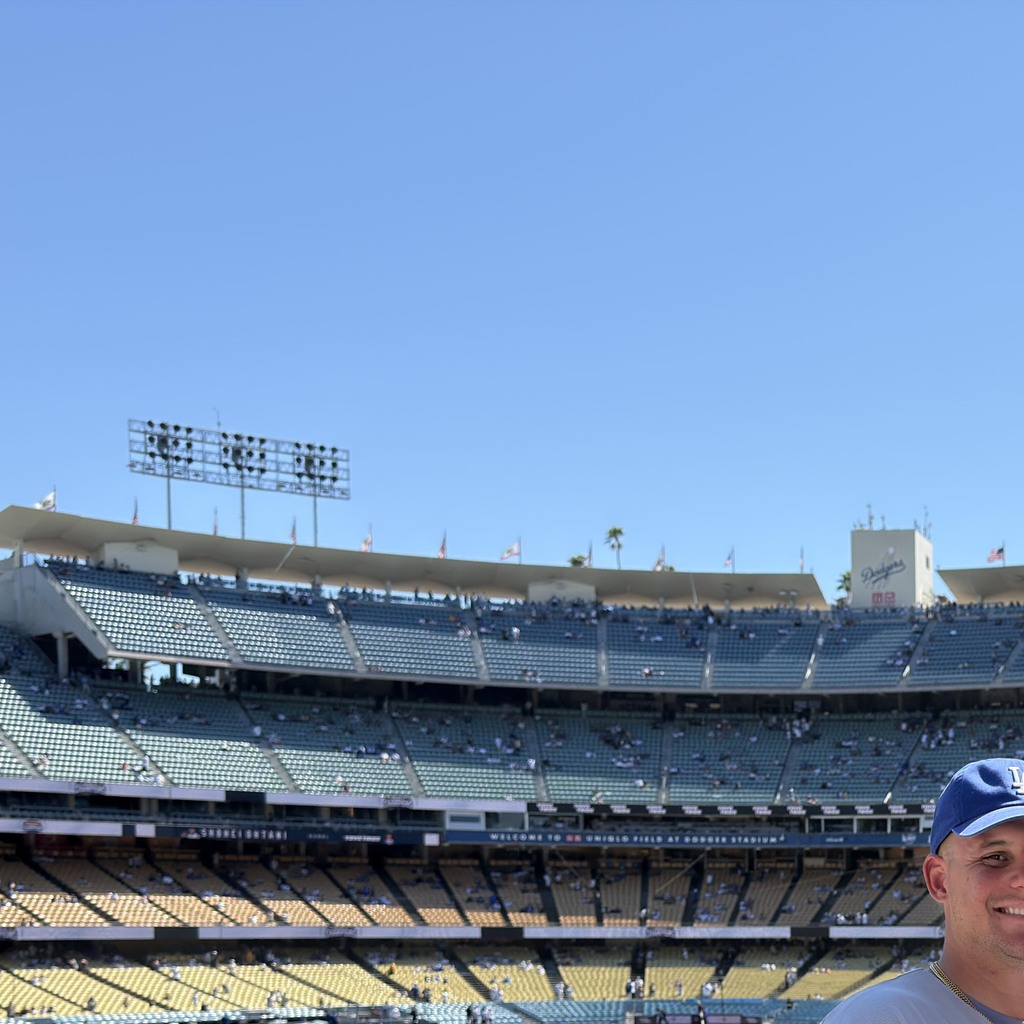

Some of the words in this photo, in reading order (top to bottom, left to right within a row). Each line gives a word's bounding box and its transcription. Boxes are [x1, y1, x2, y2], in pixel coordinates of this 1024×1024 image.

[489, 833, 543, 842] WELCOME
[547, 834, 562, 842] TO
[633, 835, 664, 843] FIELD
[683, 836, 727, 844] DODGER
[731, 836, 778, 844] STADIUM
